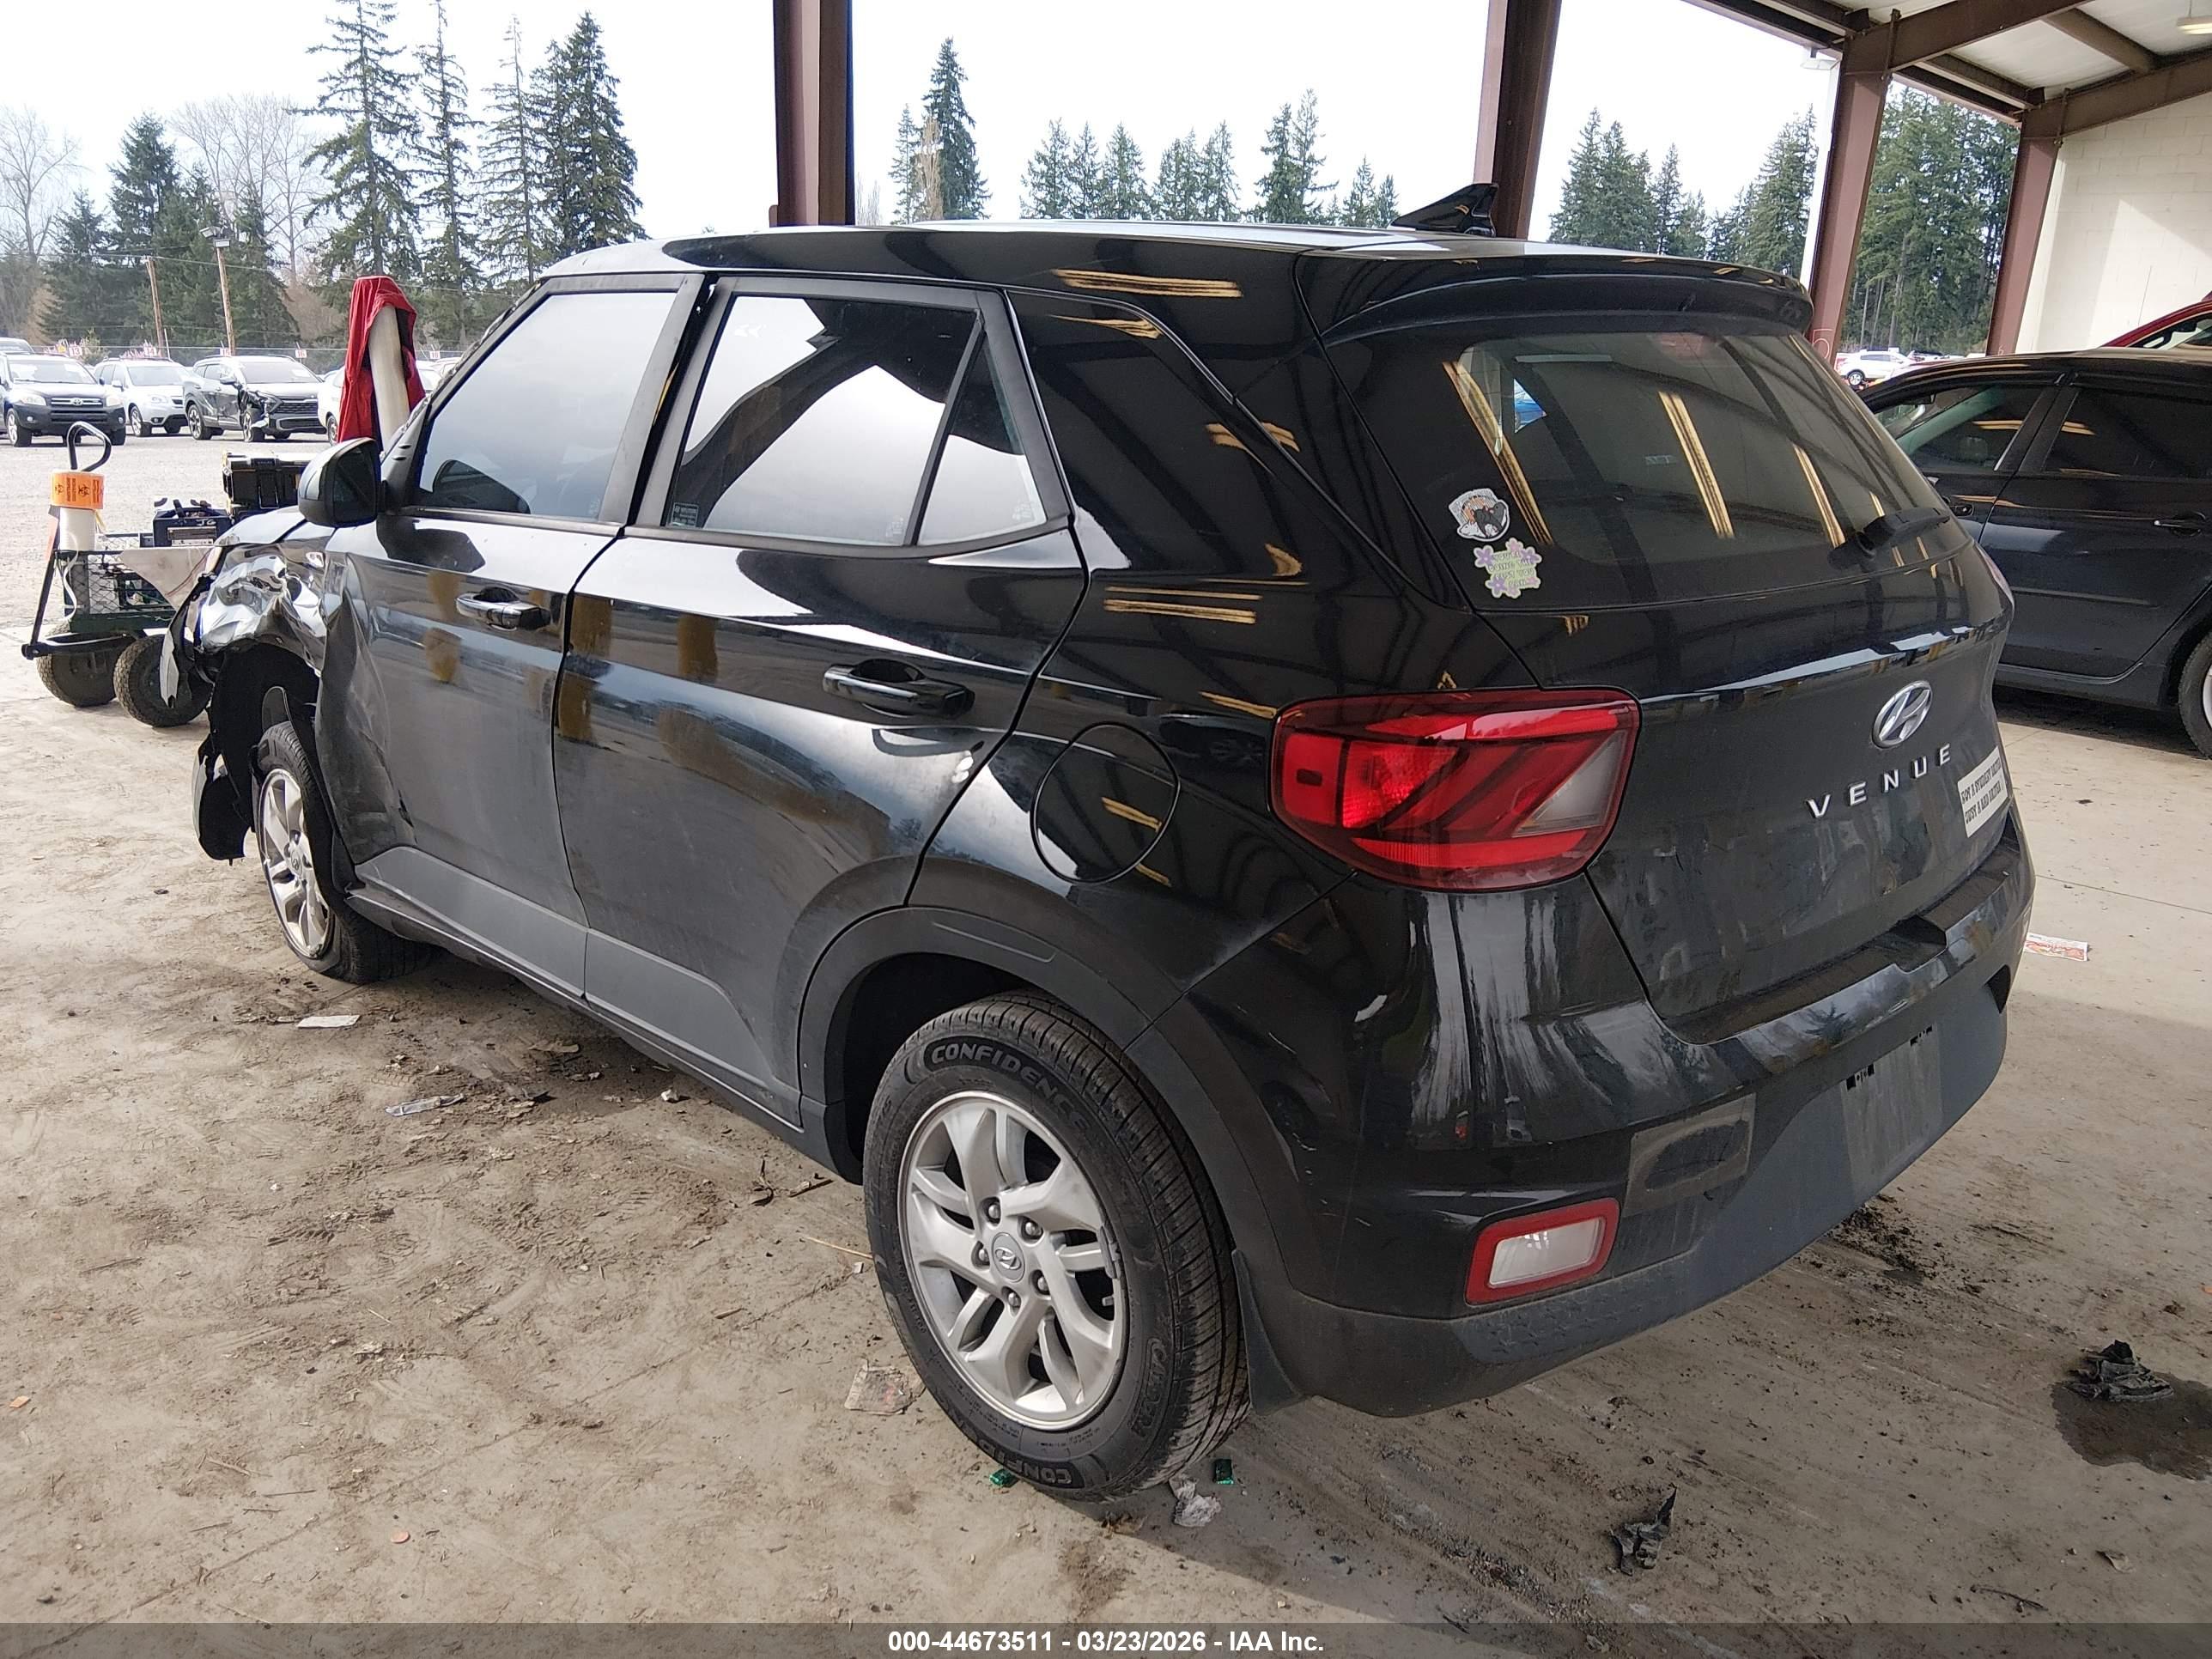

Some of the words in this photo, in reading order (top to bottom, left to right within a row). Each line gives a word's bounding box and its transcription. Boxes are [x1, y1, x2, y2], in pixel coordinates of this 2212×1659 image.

[1812, 328, 1832, 360] 5
[1807, 744, 1951, 818] VENUE
[931, 1042, 1091, 1128] CONFIDENCE
